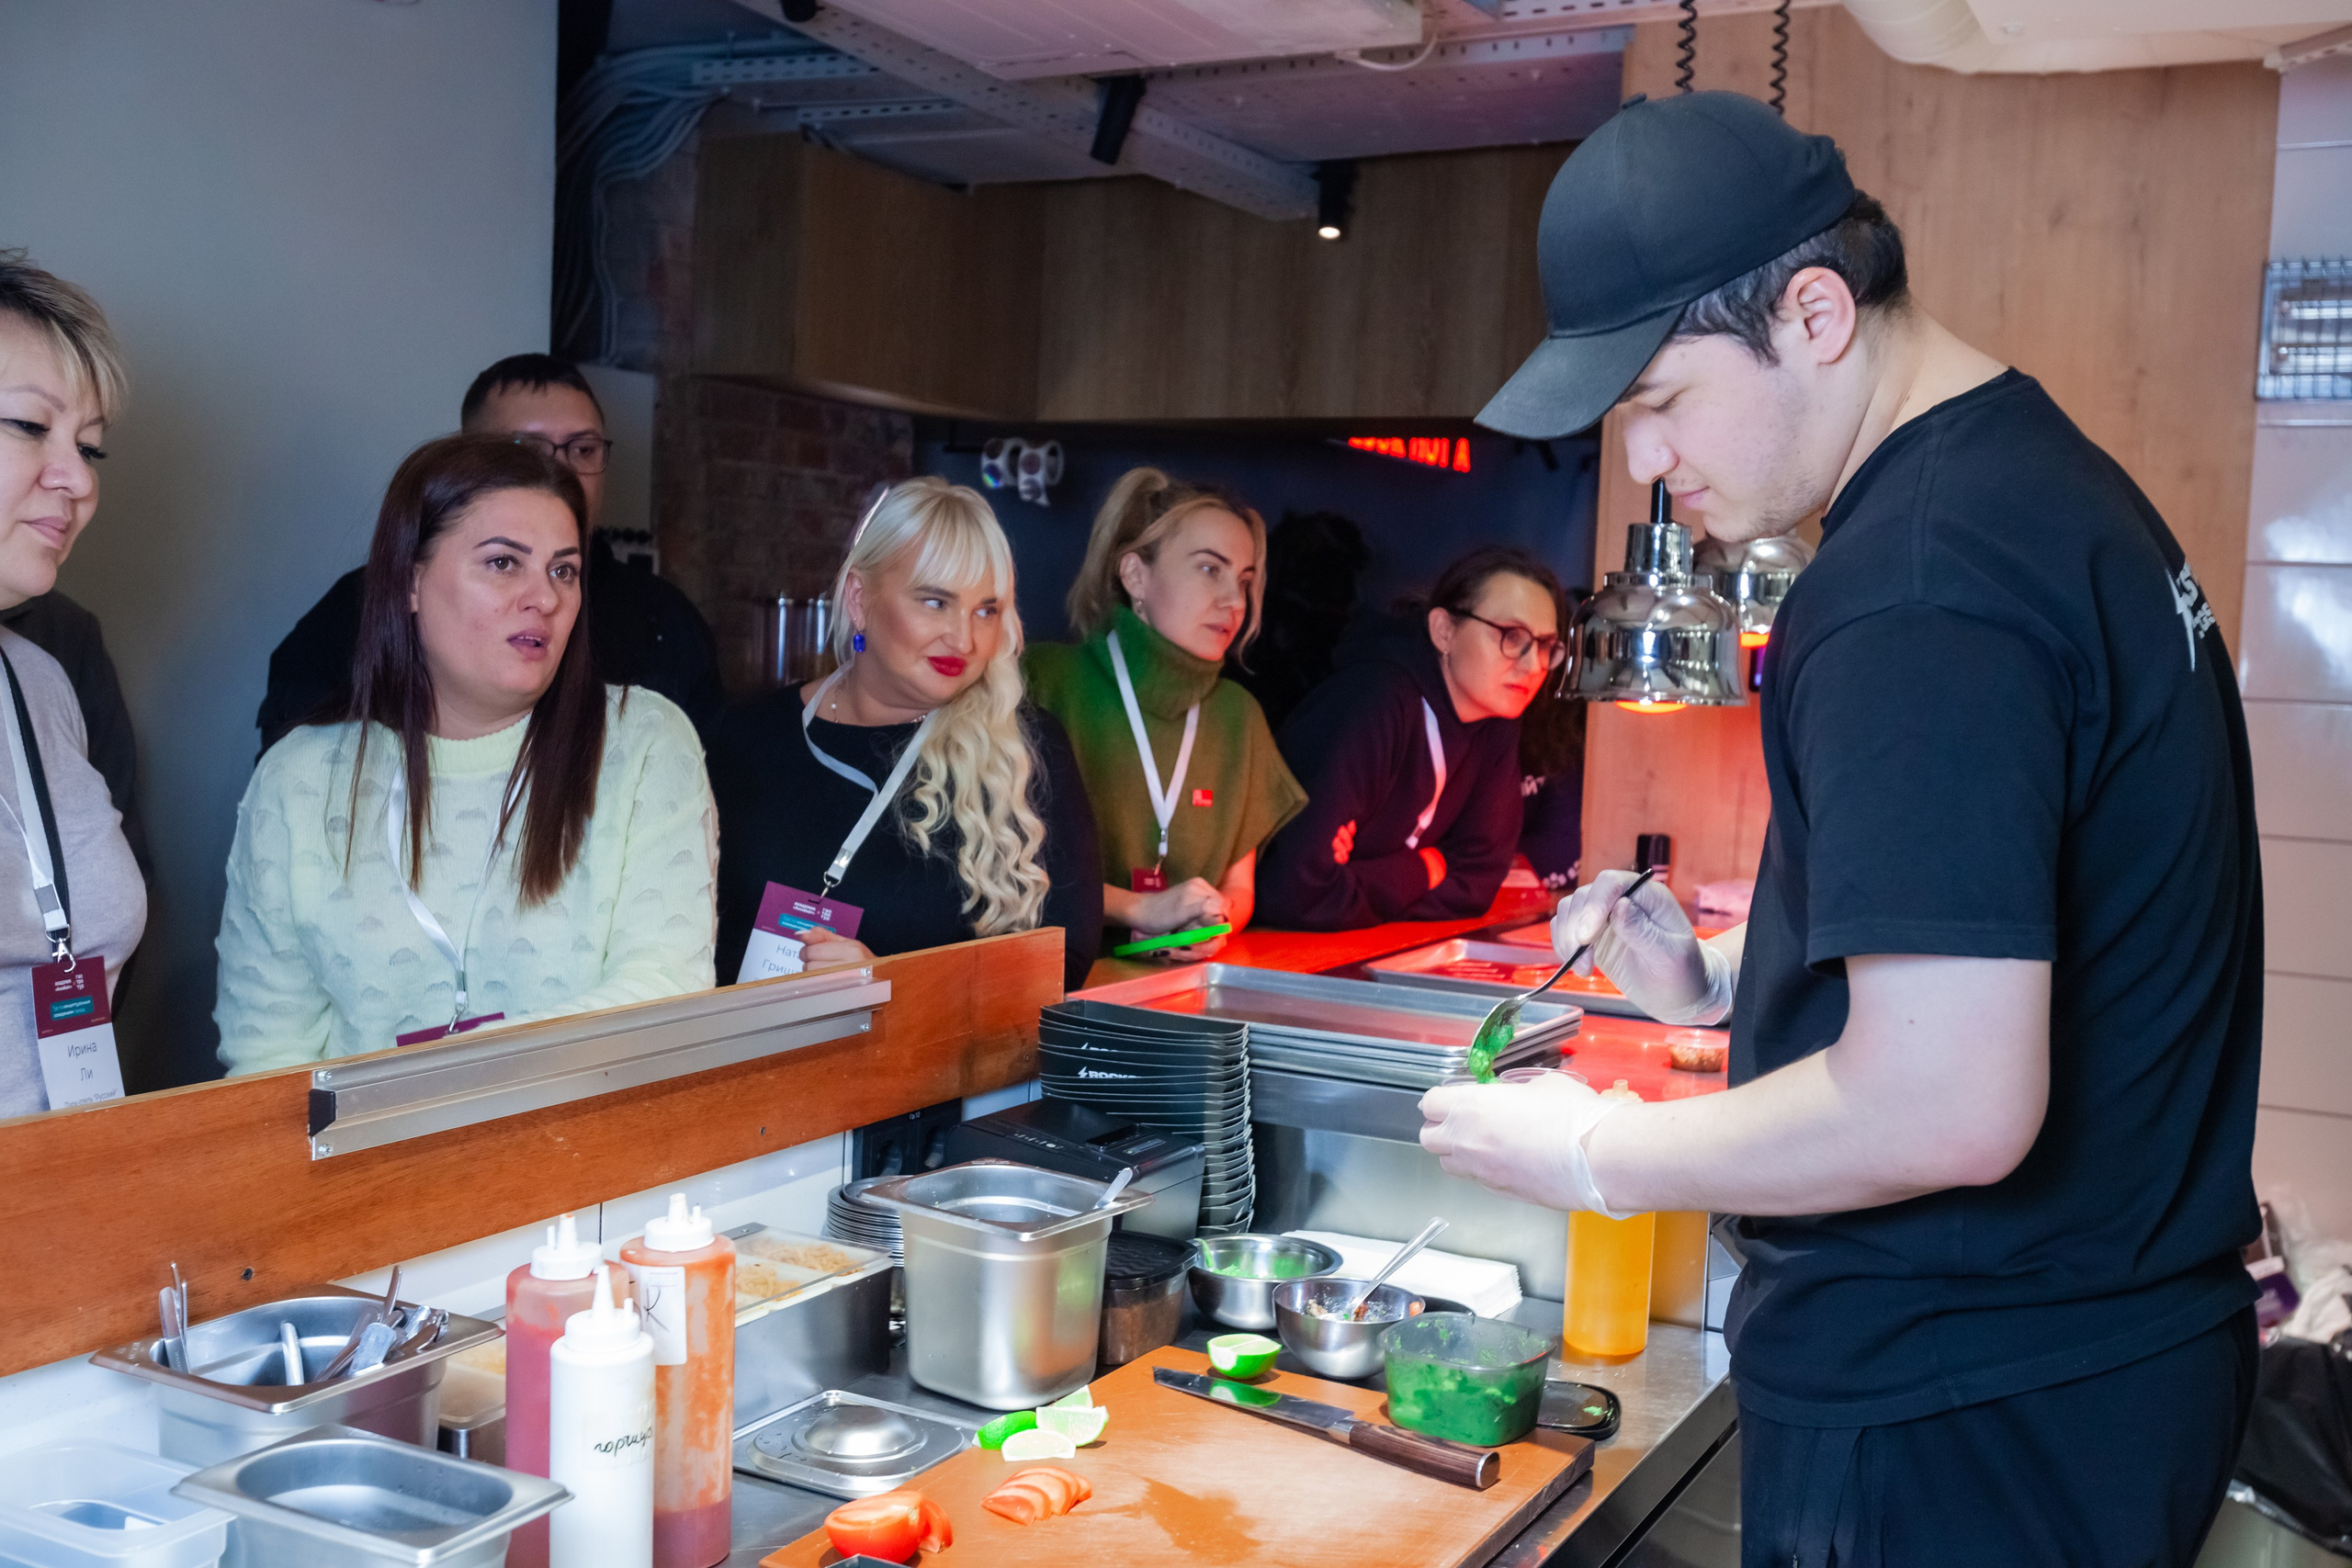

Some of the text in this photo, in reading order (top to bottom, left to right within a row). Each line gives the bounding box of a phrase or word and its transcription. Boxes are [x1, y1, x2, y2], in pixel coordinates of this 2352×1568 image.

[775, 944, 801, 960] Нат
[762, 958, 799, 975] Гриш
[67, 1042, 97, 1059] Ирина
[80, 1067, 94, 1081] Ли
[594, 1425, 654, 1458] горчица
